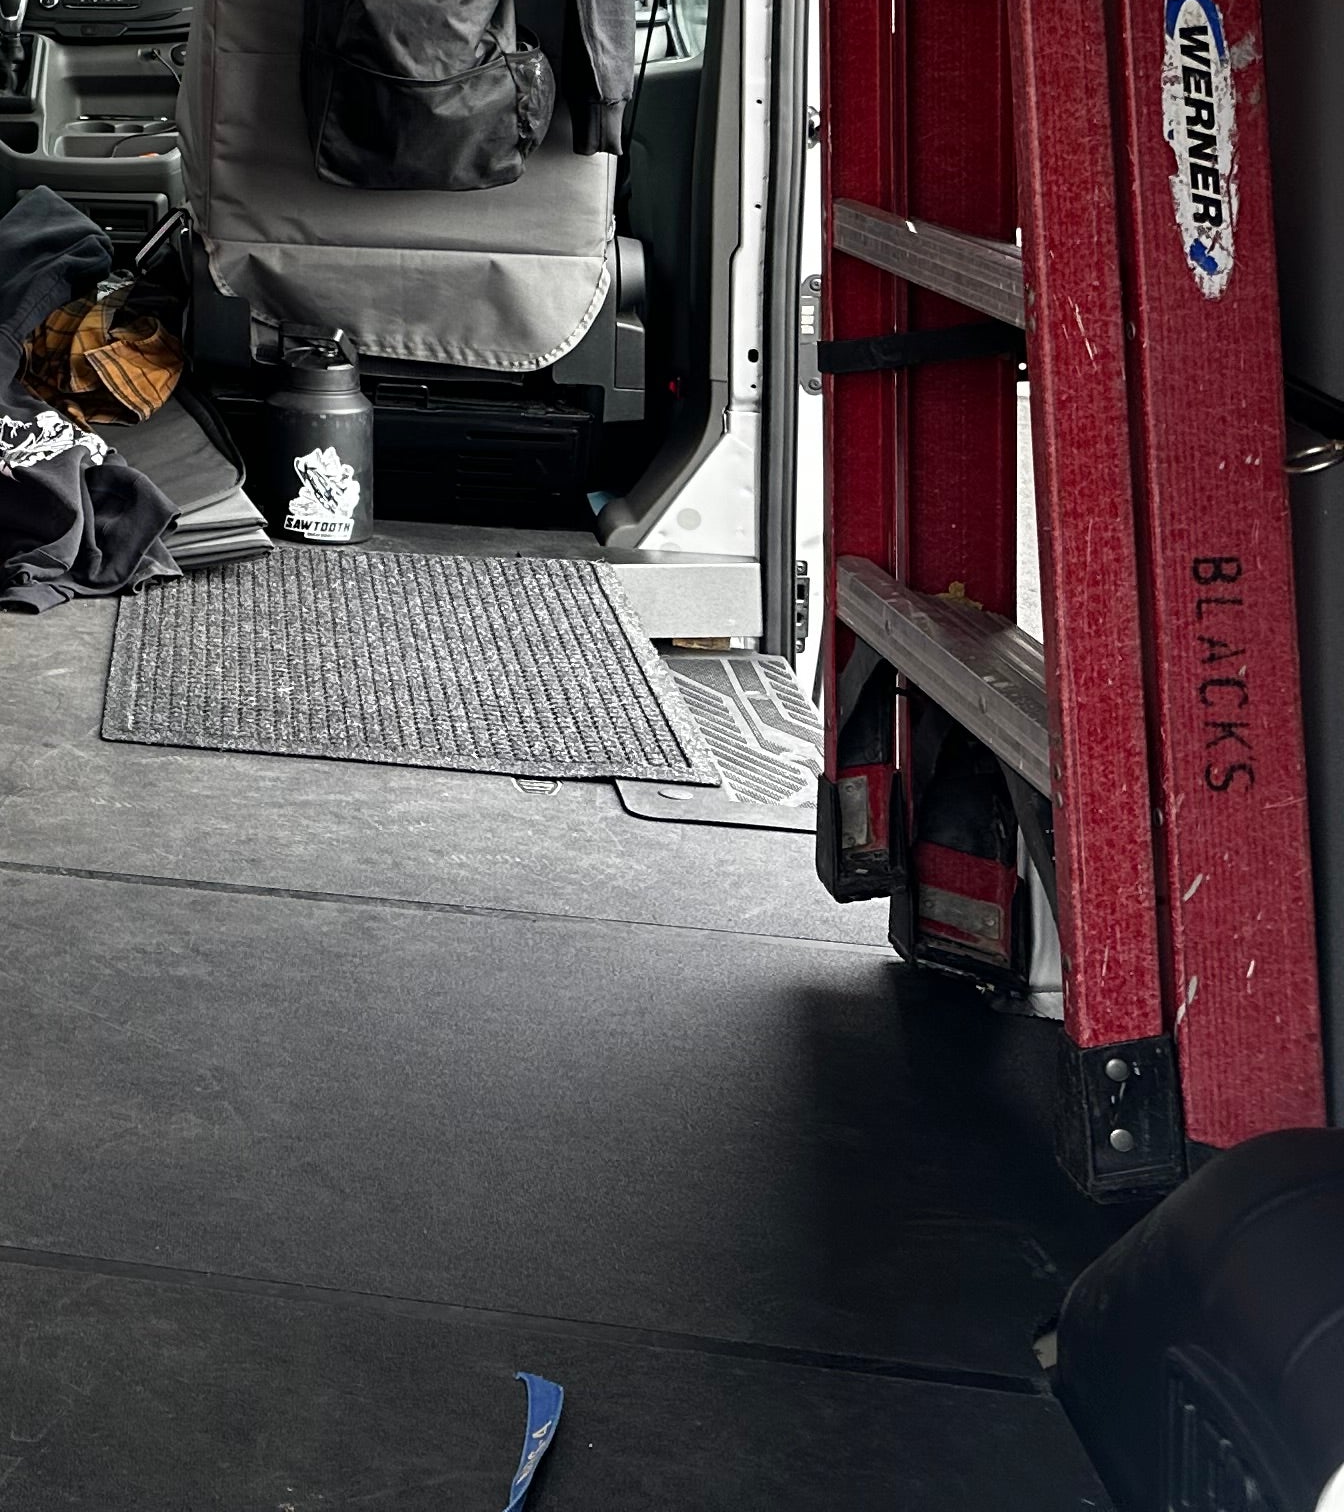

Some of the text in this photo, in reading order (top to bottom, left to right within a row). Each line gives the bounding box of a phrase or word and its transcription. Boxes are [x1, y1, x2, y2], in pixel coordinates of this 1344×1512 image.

[1178, 25, 1224, 229] WERNER
[285, 517, 351, 532] SAWTOOTH
[1191, 556, 1256, 792] BLACKS
